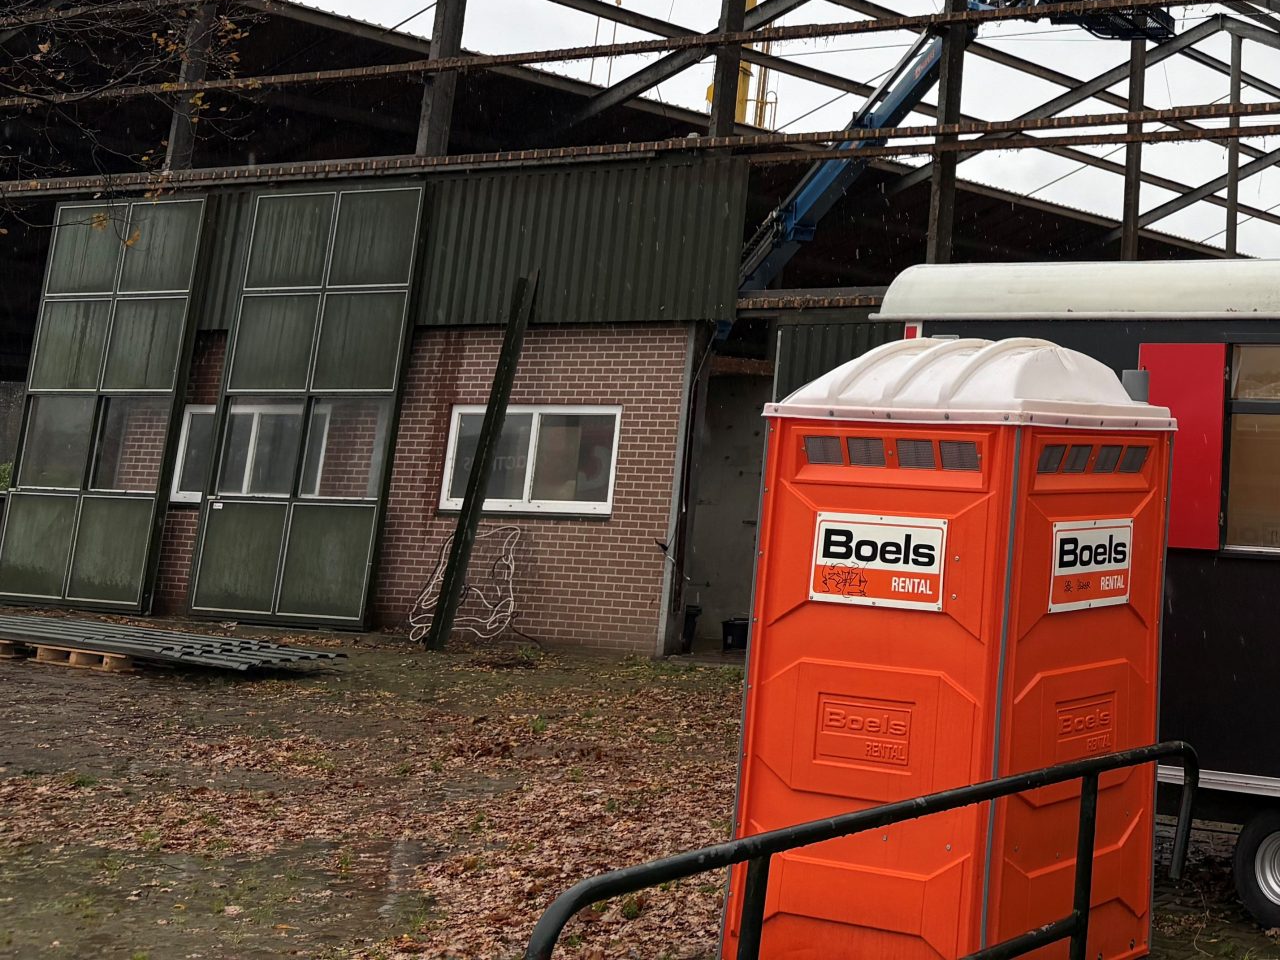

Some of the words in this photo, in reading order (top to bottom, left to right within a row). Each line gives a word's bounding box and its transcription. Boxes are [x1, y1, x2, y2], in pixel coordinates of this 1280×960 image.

[822, 528, 936, 567] Boels
[1058, 534, 1127, 569] Boels
[891, 576, 933, 595] RENTAL
[1100, 574, 1125, 591] RENTAL
[824, 707, 908, 736] Boels
[865, 741, 906, 761] RENTAL
